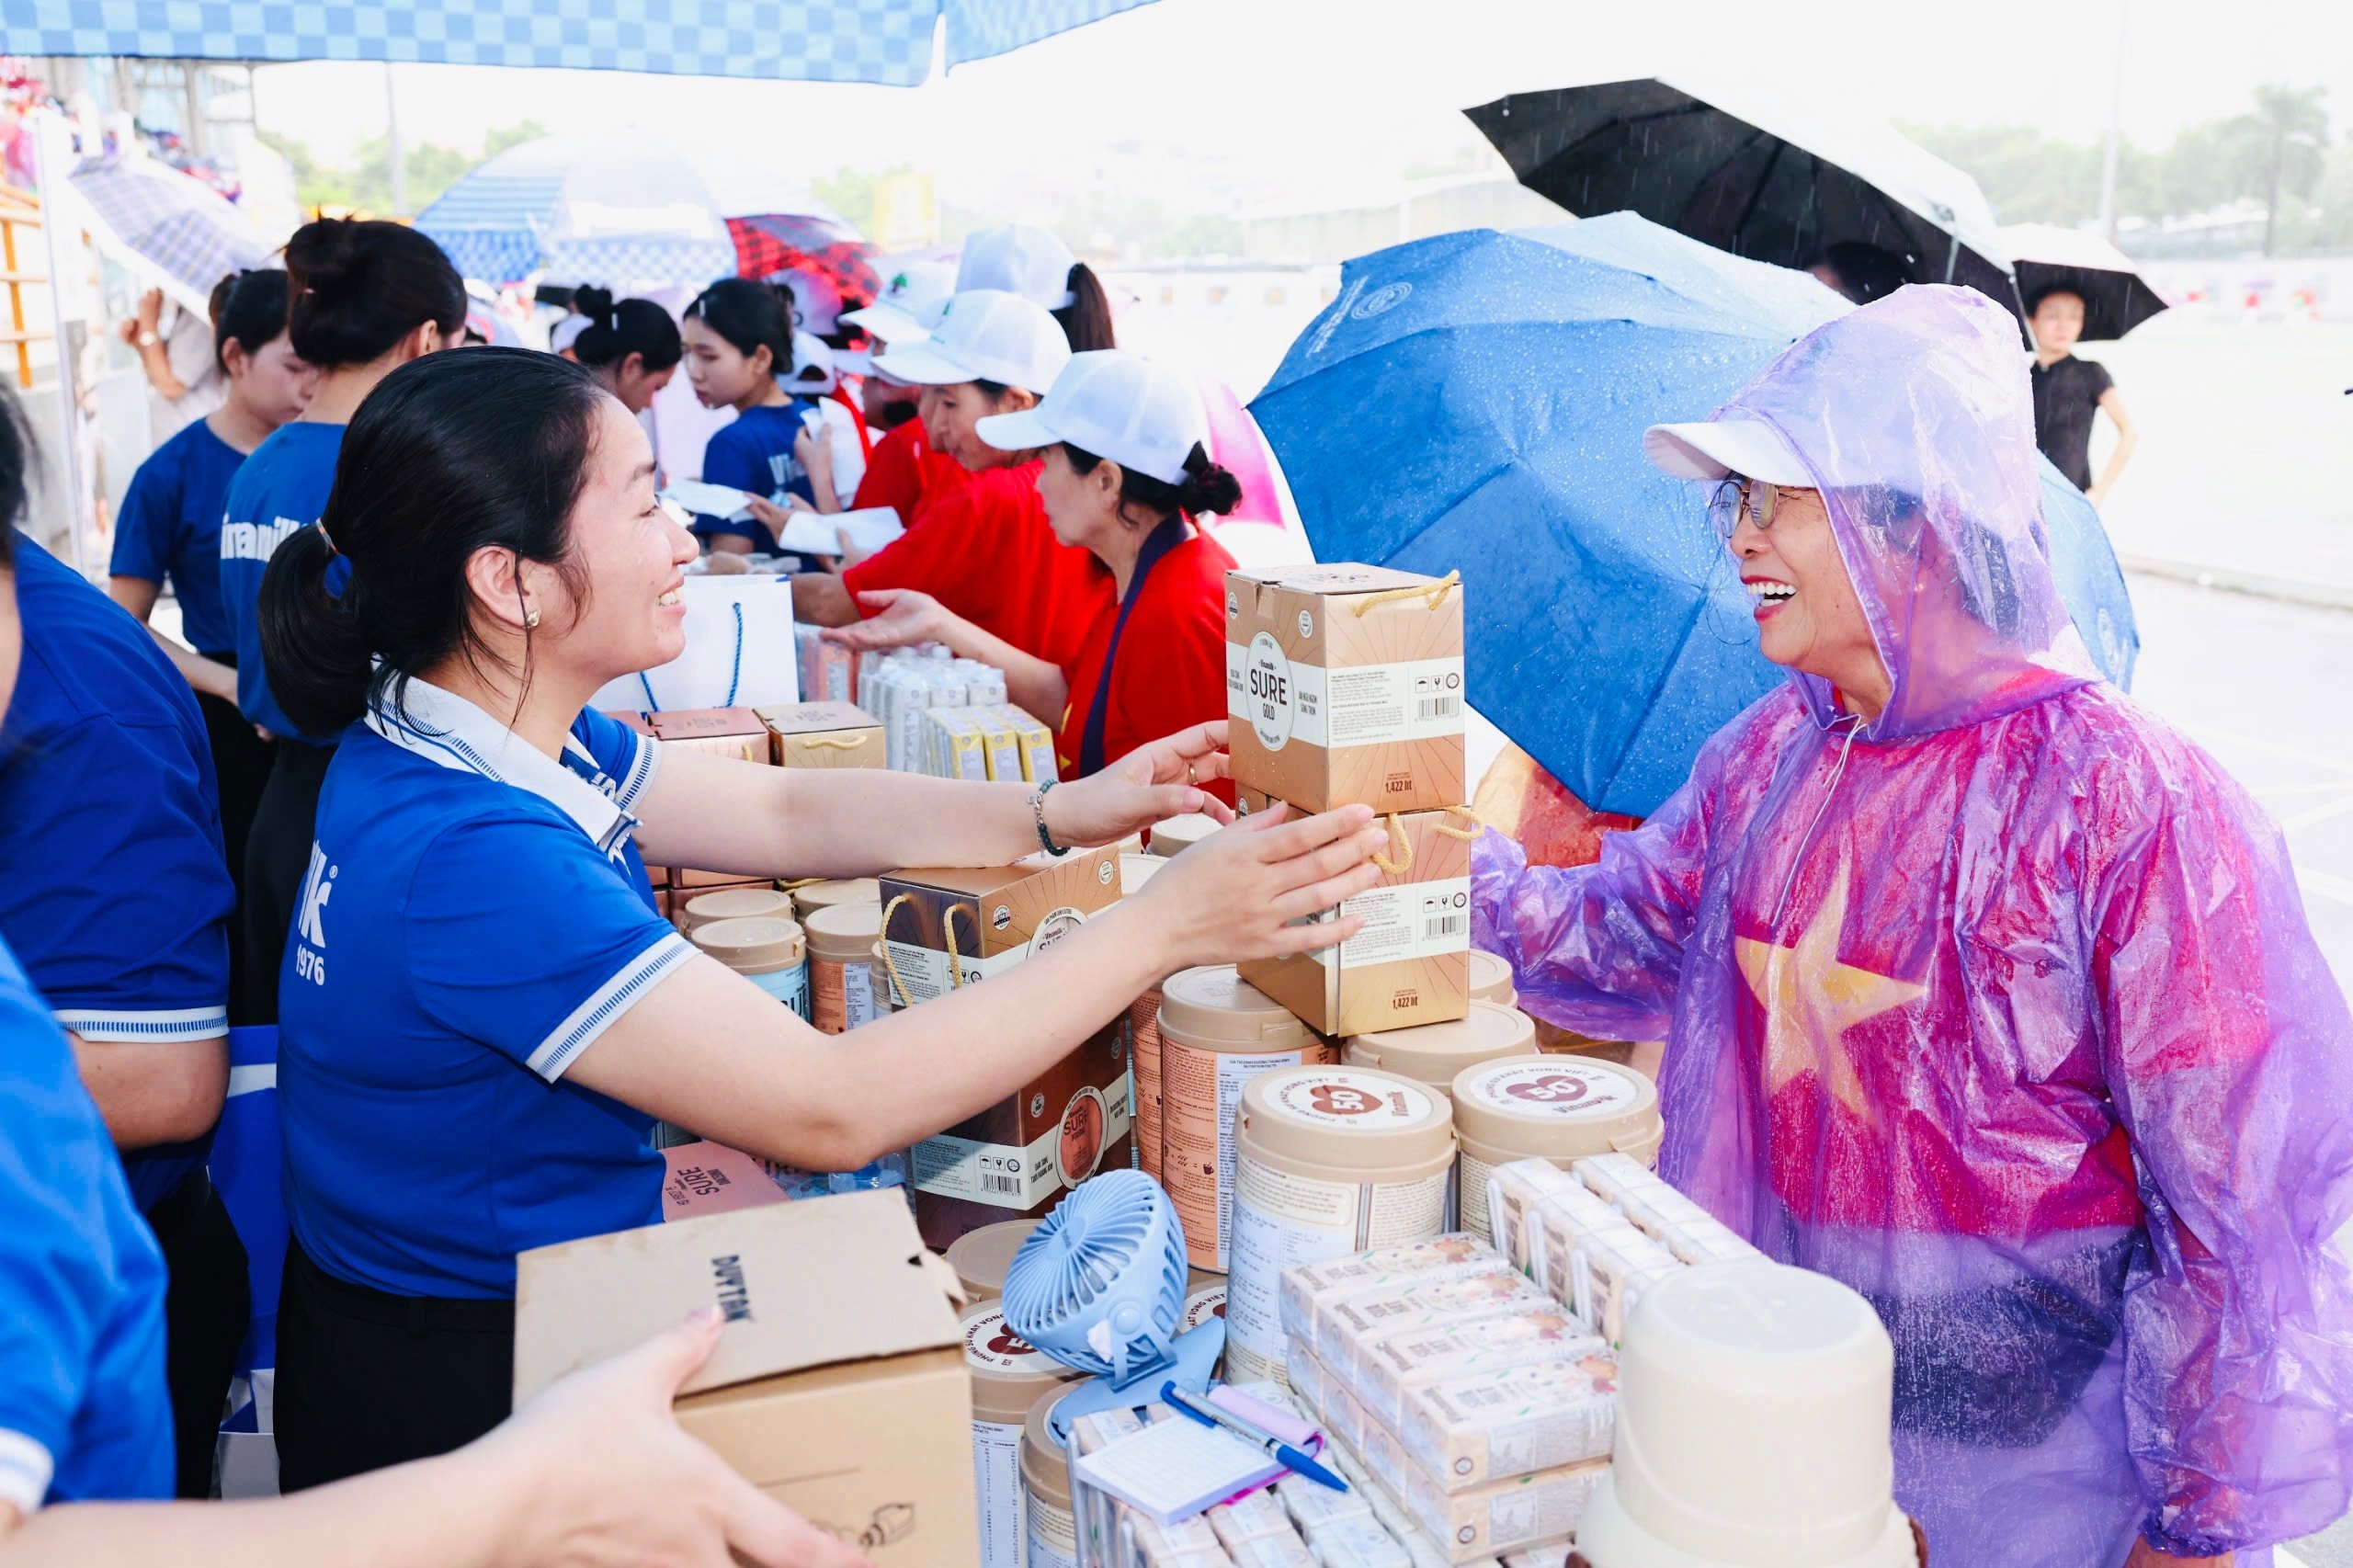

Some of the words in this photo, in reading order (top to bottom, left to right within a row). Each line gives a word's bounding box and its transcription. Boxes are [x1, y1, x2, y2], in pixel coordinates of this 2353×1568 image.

[1250, 668, 1287, 706] SURE
[1263, 703, 1276, 721] GOLD
[1385, 780, 1404, 794] 1,422
[296, 944, 325, 986] 1976
[1392, 996, 1409, 1010] 1,422
[1331, 1090, 1365, 1112] 50
[1525, 1080, 1578, 1100] 50
[1063, 1109, 1088, 1136] SURE
[677, 1166, 720, 1195] SURE
